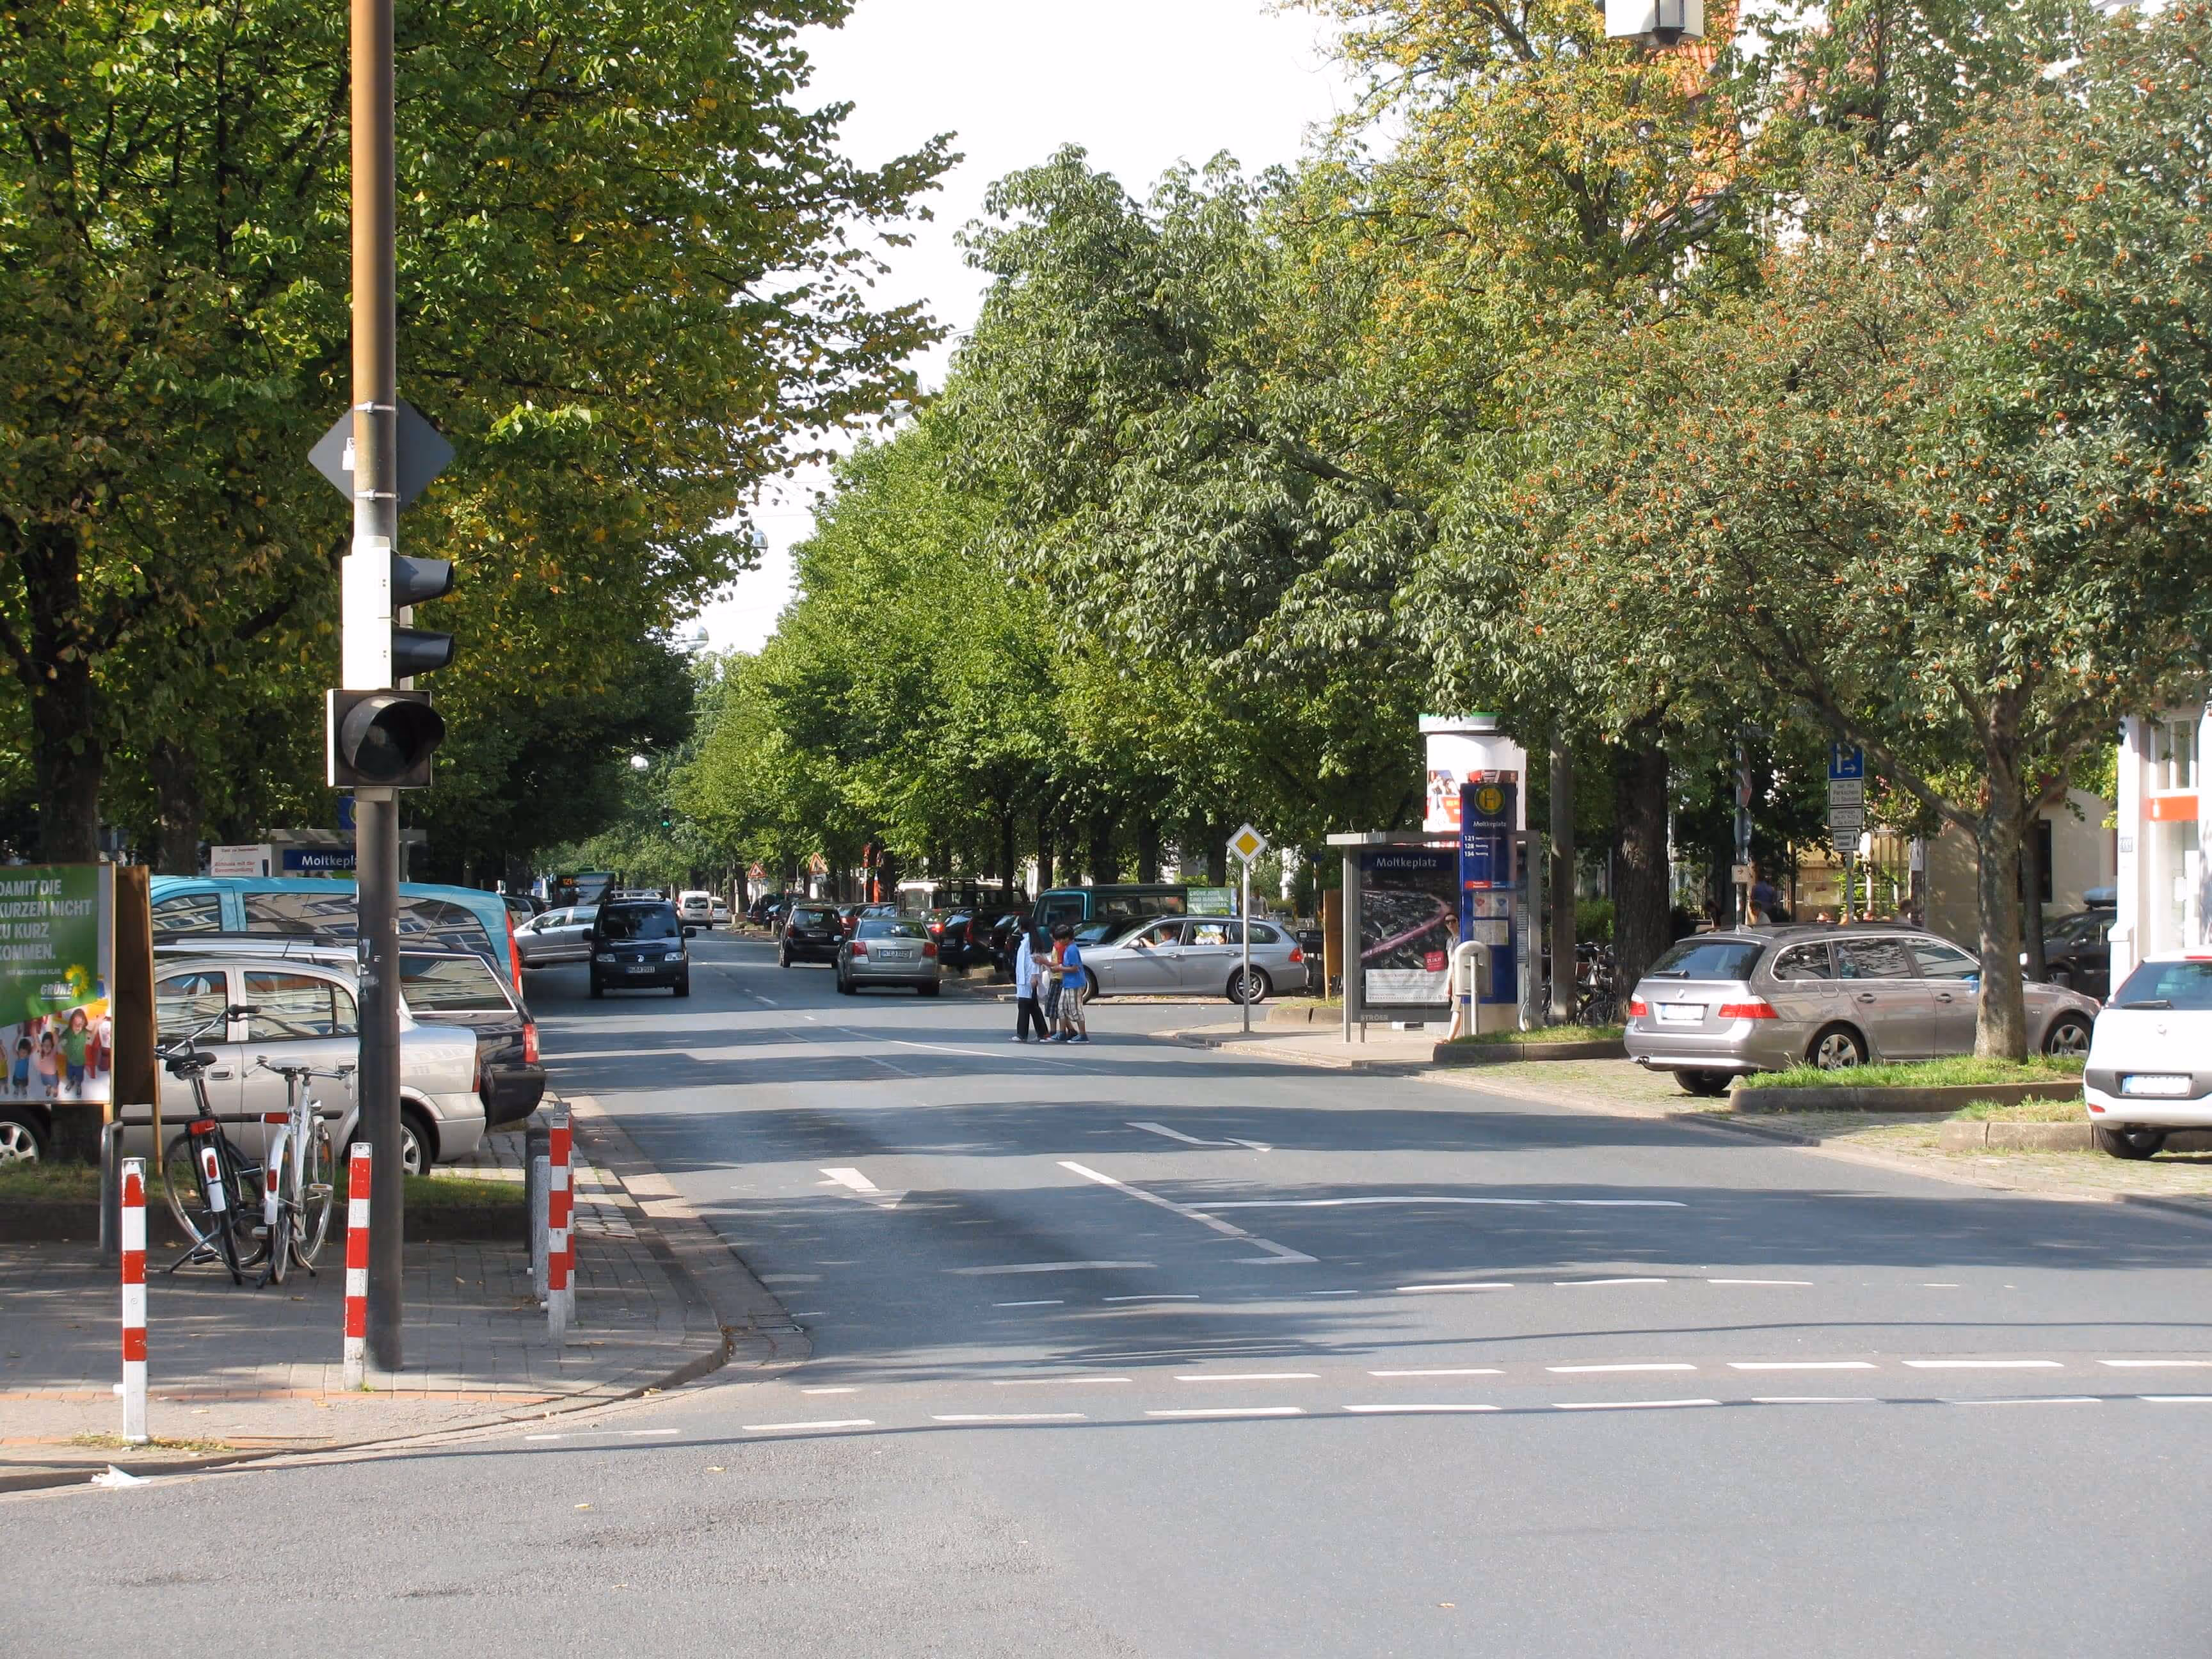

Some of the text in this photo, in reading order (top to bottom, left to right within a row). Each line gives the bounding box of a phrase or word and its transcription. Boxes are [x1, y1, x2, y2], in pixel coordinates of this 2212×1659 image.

[1483, 789, 1496, 810] H
[1376, 857, 1438, 869] Moltkeplatz
[40, 879, 62, 895] DIE
[51, 899, 93, 917] NICHT
[15, 922, 50, 939] KURZ
[40, 981, 72, 995] GRÜNE
